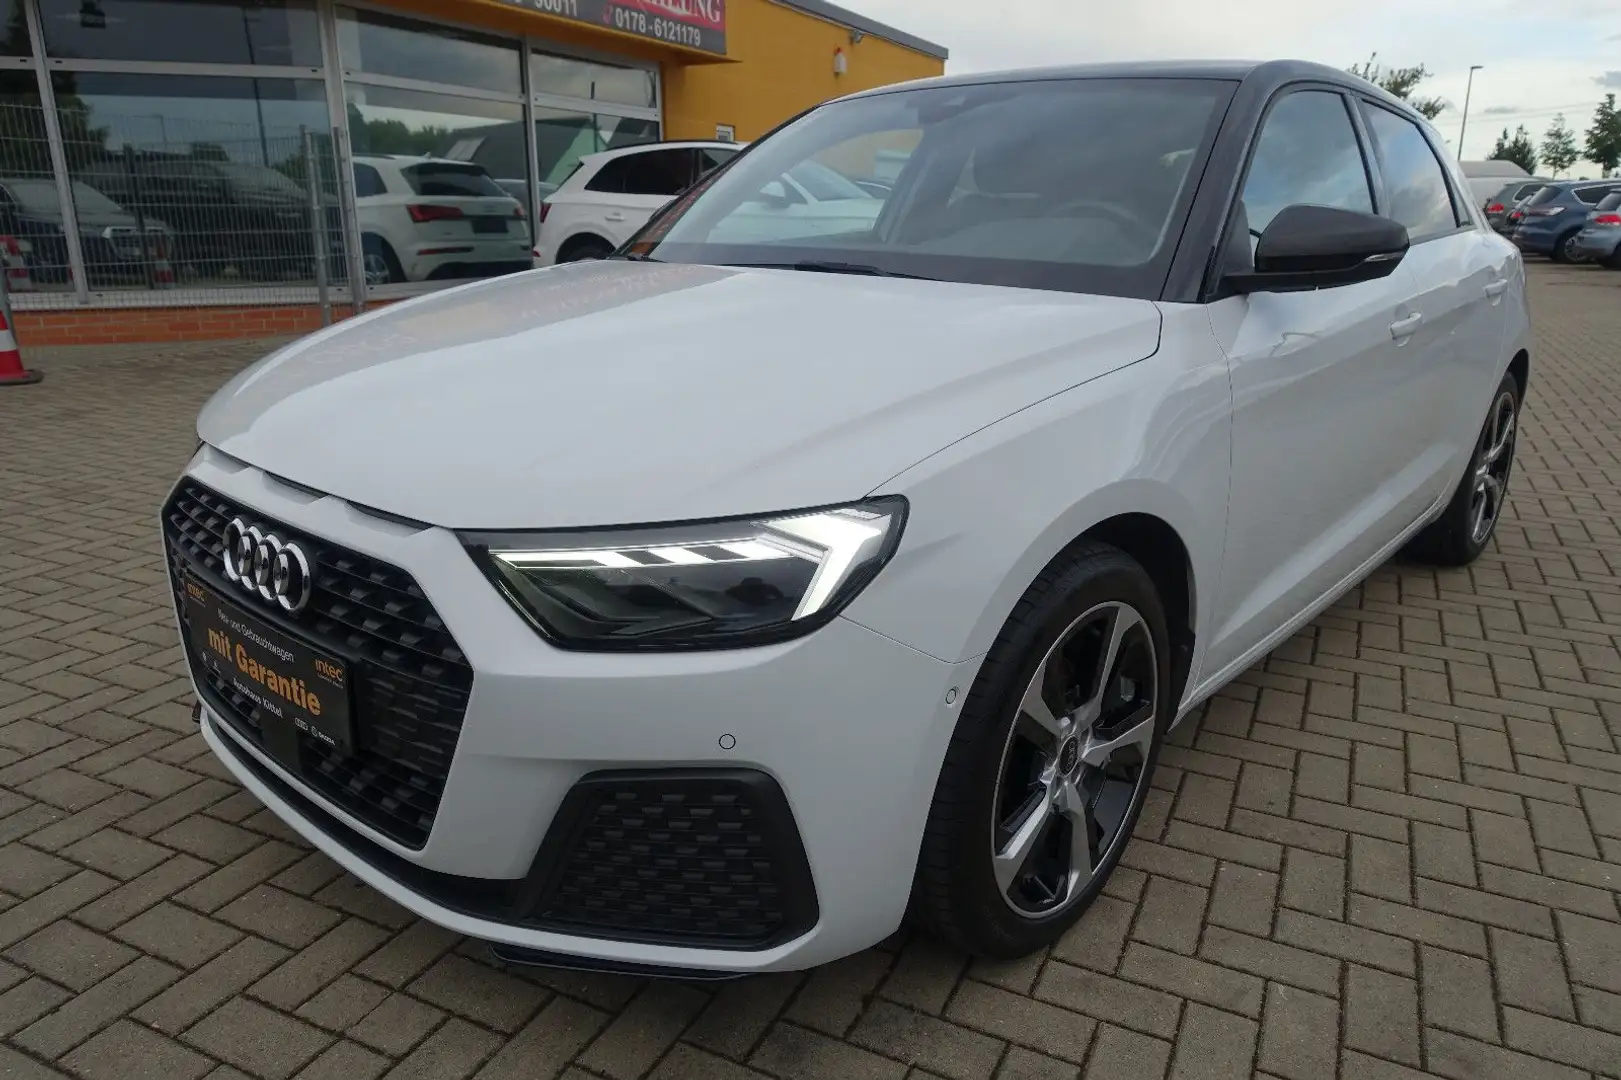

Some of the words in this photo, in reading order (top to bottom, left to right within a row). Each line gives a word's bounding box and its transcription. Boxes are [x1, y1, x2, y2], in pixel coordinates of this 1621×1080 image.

[241, 624, 294, 663] Gebrauchtwagen
[207, 627, 233, 663] mit
[235, 643, 321, 716] Garantie
[315, 659, 343, 682] intec
